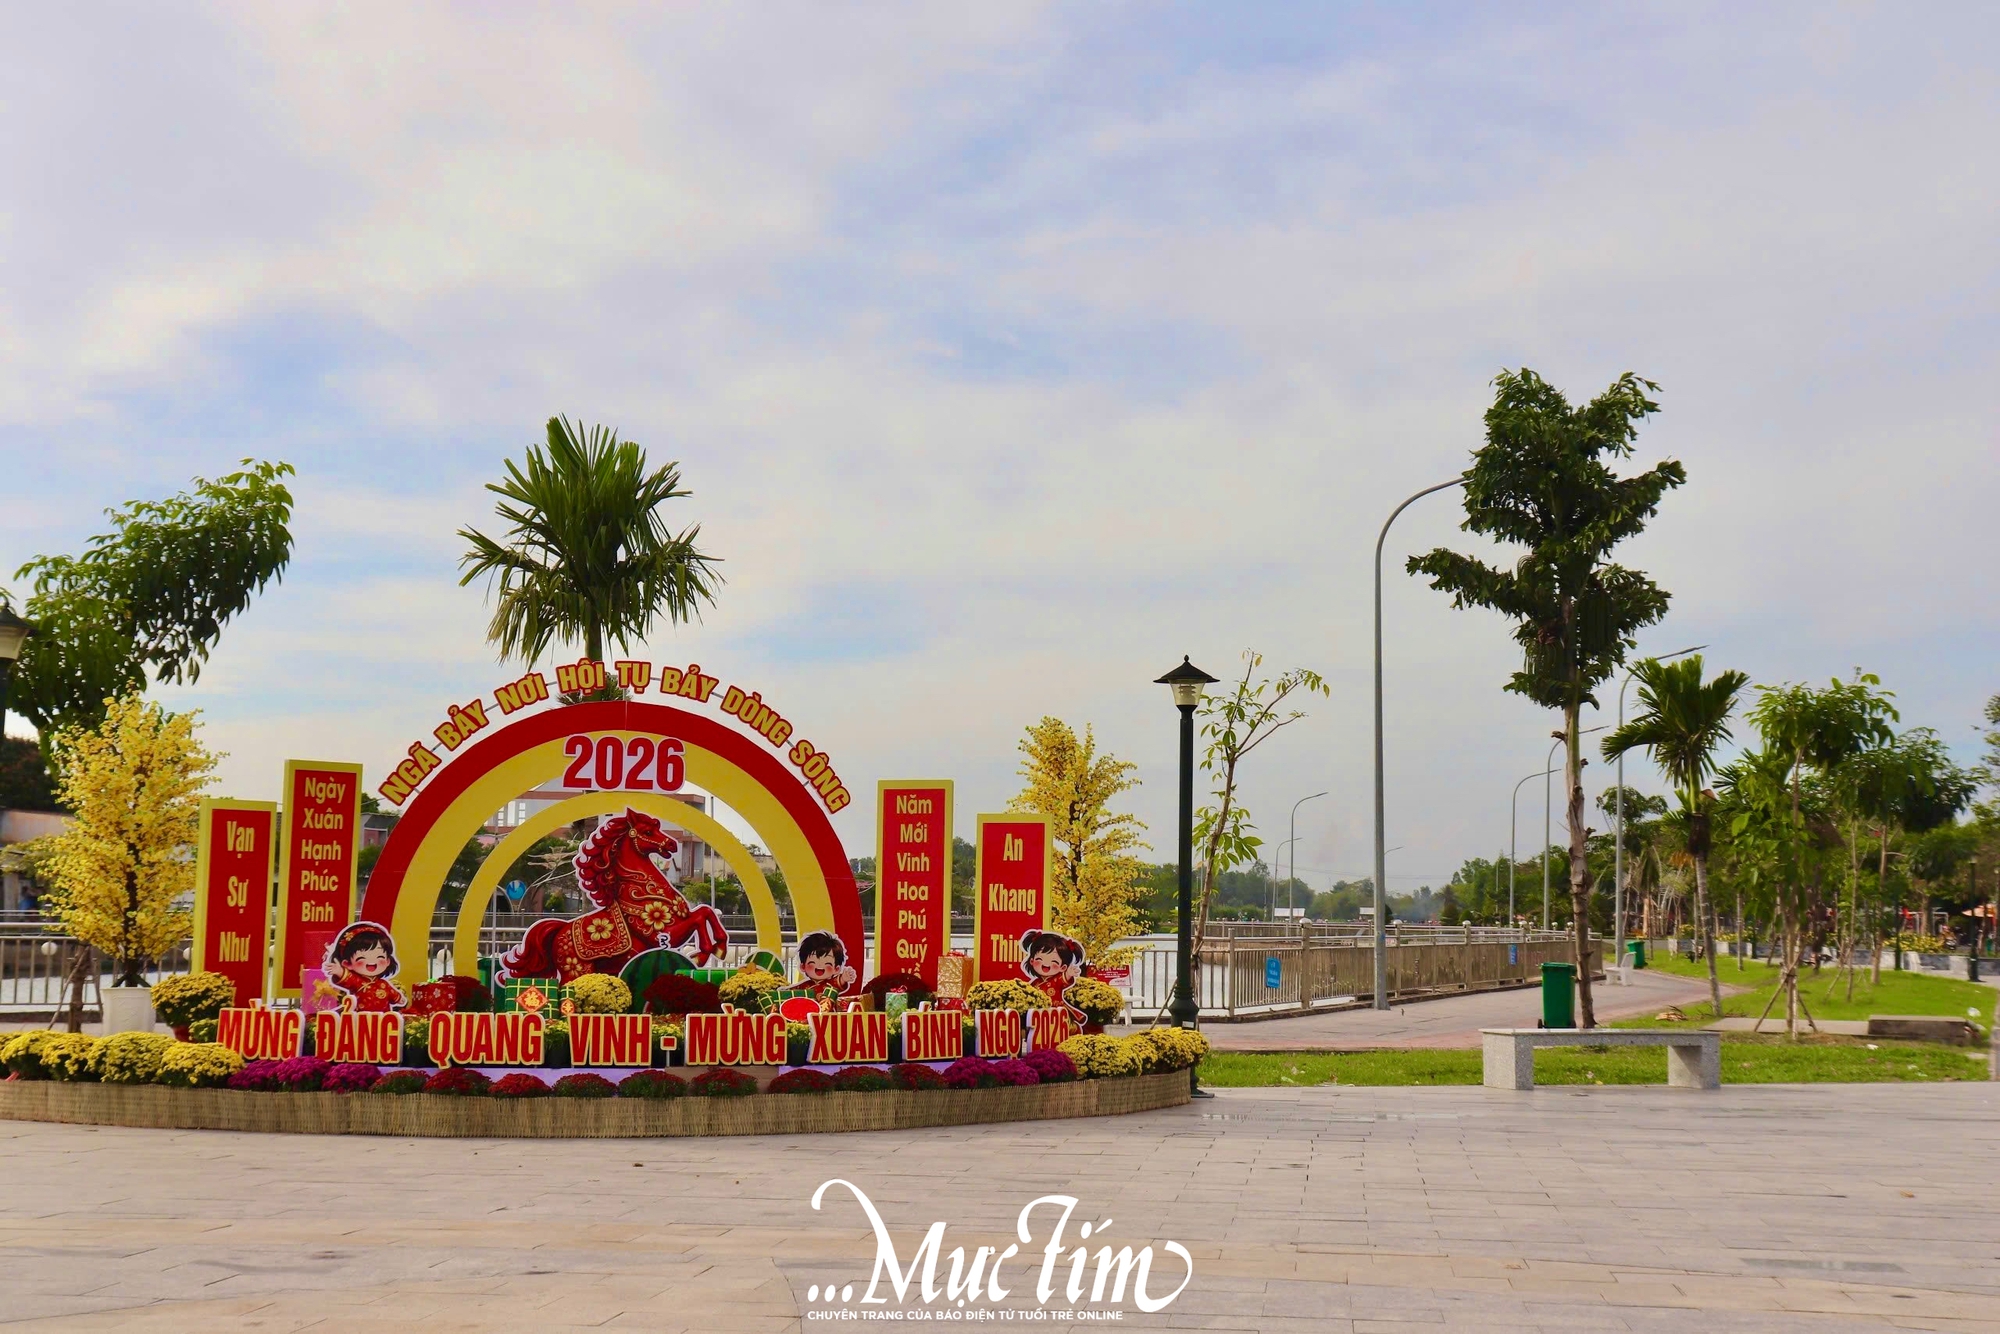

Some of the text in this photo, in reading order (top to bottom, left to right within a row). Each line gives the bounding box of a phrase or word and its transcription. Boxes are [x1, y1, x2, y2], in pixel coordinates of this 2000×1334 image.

[379, 657, 850, 814] NGÃ BẢY NƠI HỘI TỤ BẢY DÒNG SÔNG
[563, 734, 686, 791] 2026
[305, 776, 346, 804] Ngày
[896, 794, 932, 814] Năm
[302, 807, 343, 829] Xuân
[227, 821, 255, 858] Vạn
[900, 822, 927, 842] Mới
[301, 839, 341, 866] Hạnh
[1003, 833, 1023, 861] An
[897, 853, 930, 872] Vinh
[301, 869, 339, 891] Phúc
[897, 881, 929, 900] Hoa
[227, 876, 248, 914] Sự
[988, 883, 1036, 915] Khang
[301, 900, 334, 922] Bình
[898, 908, 926, 930] Phú
[219, 931, 250, 962] Như
[896, 938, 928, 963] Quý
[991, 934, 1028, 968] Thịn
[217, 999, 301, 1060] MỪNG
[316, 998, 401, 1063] ĐẢNG
[429, 1012, 544, 1069] QUANG
[568, 1013, 652, 1065] VINH
[686, 1003, 787, 1065] MỪNG
[808, 1002, 888, 1063] XUÂN
[906, 1002, 962, 1060] BÍNH
[979, 1009, 1020, 1060] NGỌ
[1031, 1009, 1069, 1052] 2026
